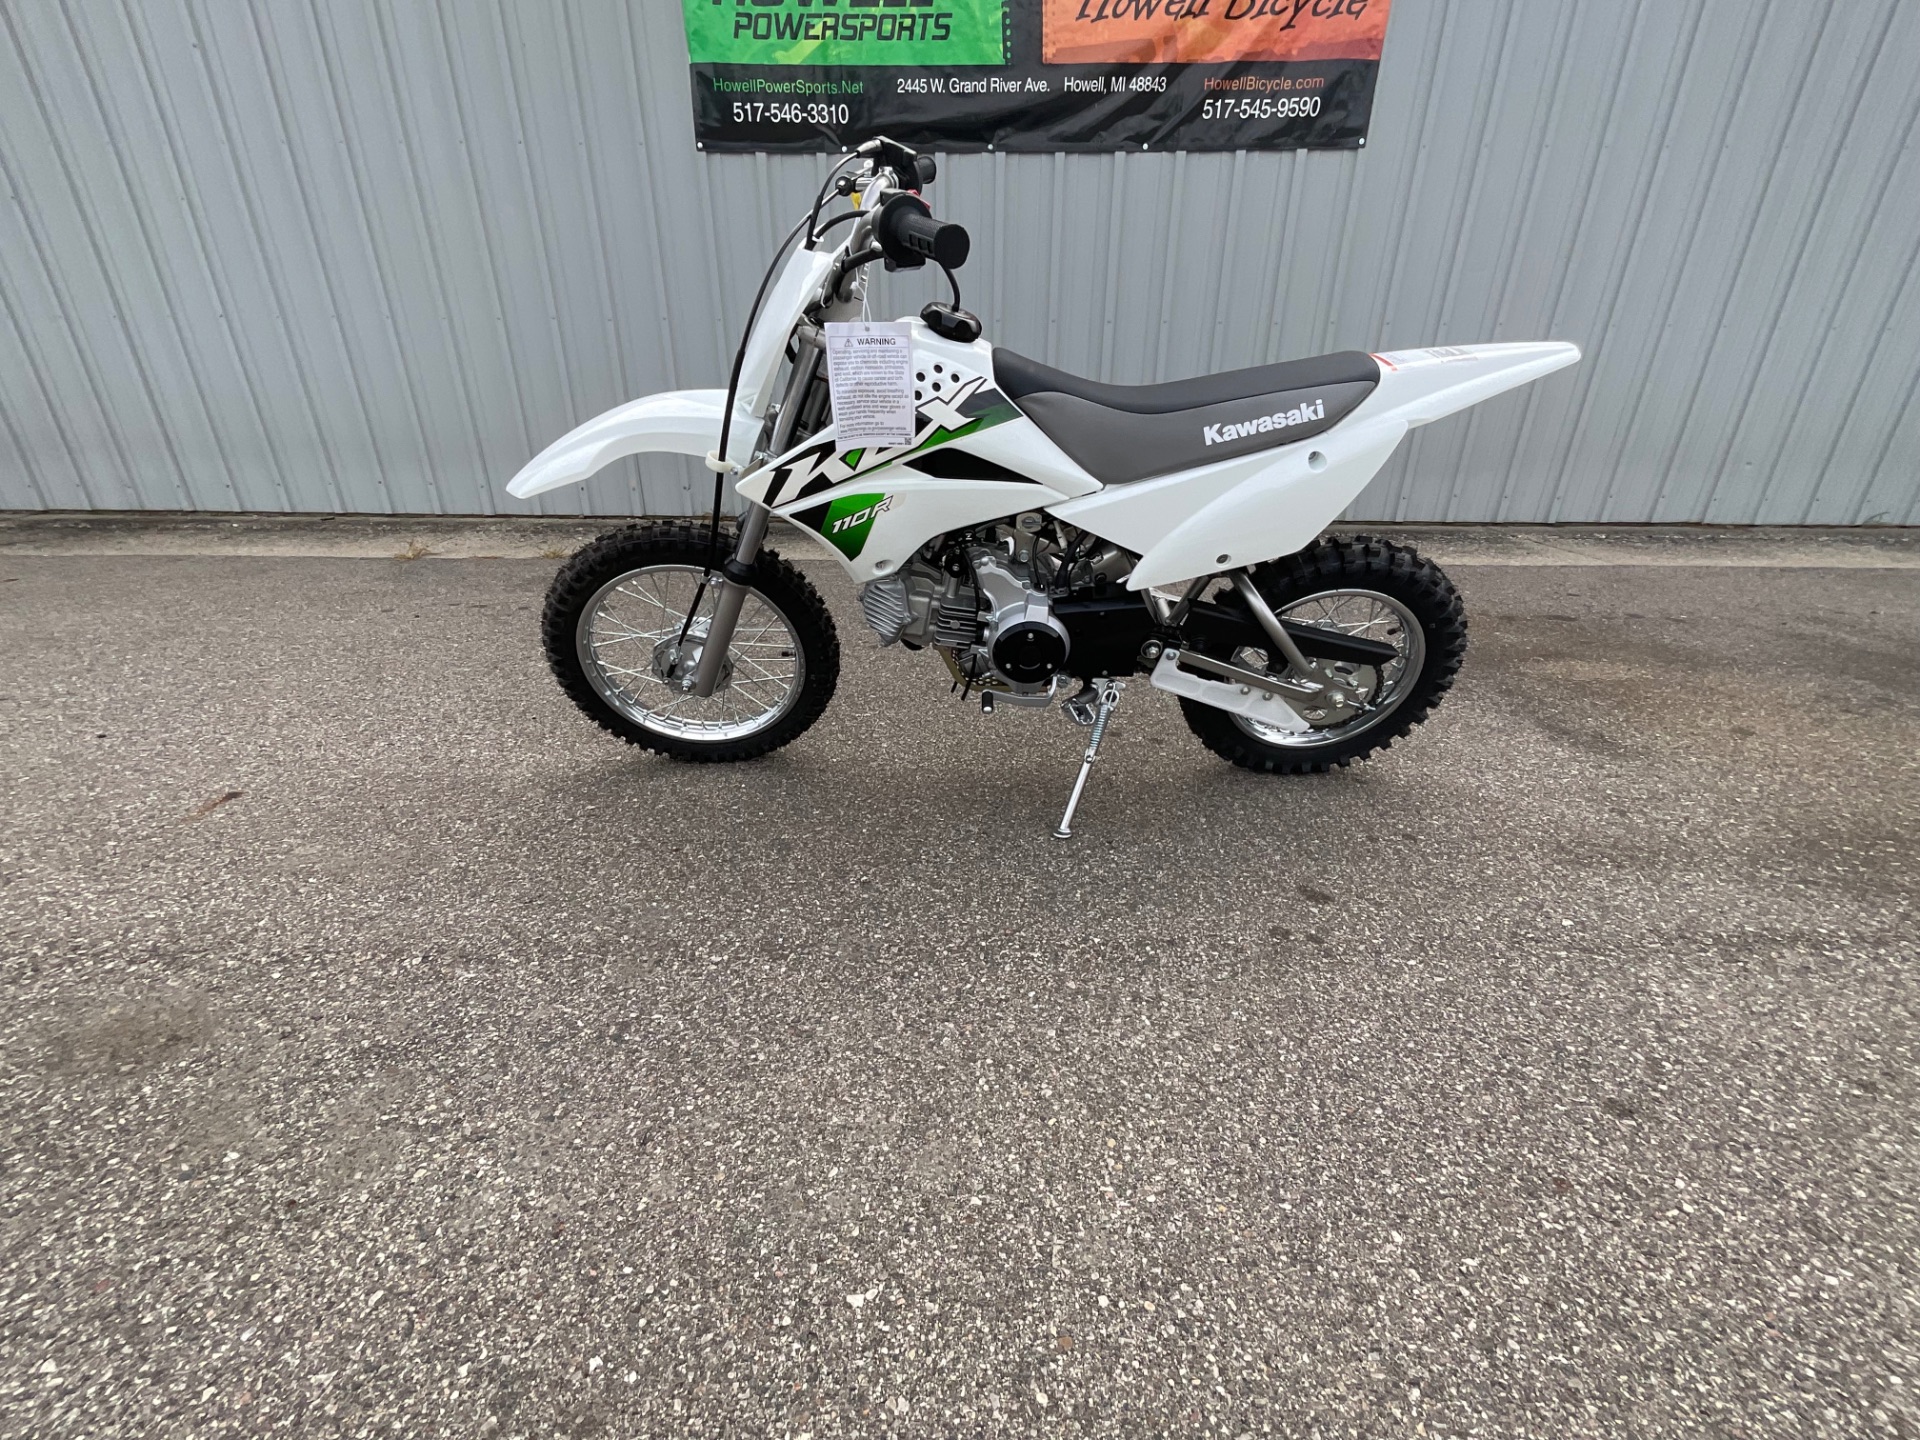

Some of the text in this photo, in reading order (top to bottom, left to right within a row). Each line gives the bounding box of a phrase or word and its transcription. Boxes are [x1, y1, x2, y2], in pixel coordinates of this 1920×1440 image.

[733, 12, 953, 41] POWERSPORTS
[713, 78, 864, 96] HowellPowerSports.Net
[897, 76, 1167, 94] 2445 W. Grand River Ave. Howell, MI 48843
[1203, 76, 1324, 94] HowellBicycle.com
[733, 102, 850, 124] 517-546-3310
[1202, 96, 1321, 119] 517-545-9590
[857, 337, 896, 346] WARNING
[1203, 399, 1325, 446] Kawasaki
[832, 495, 894, 534] 110R
